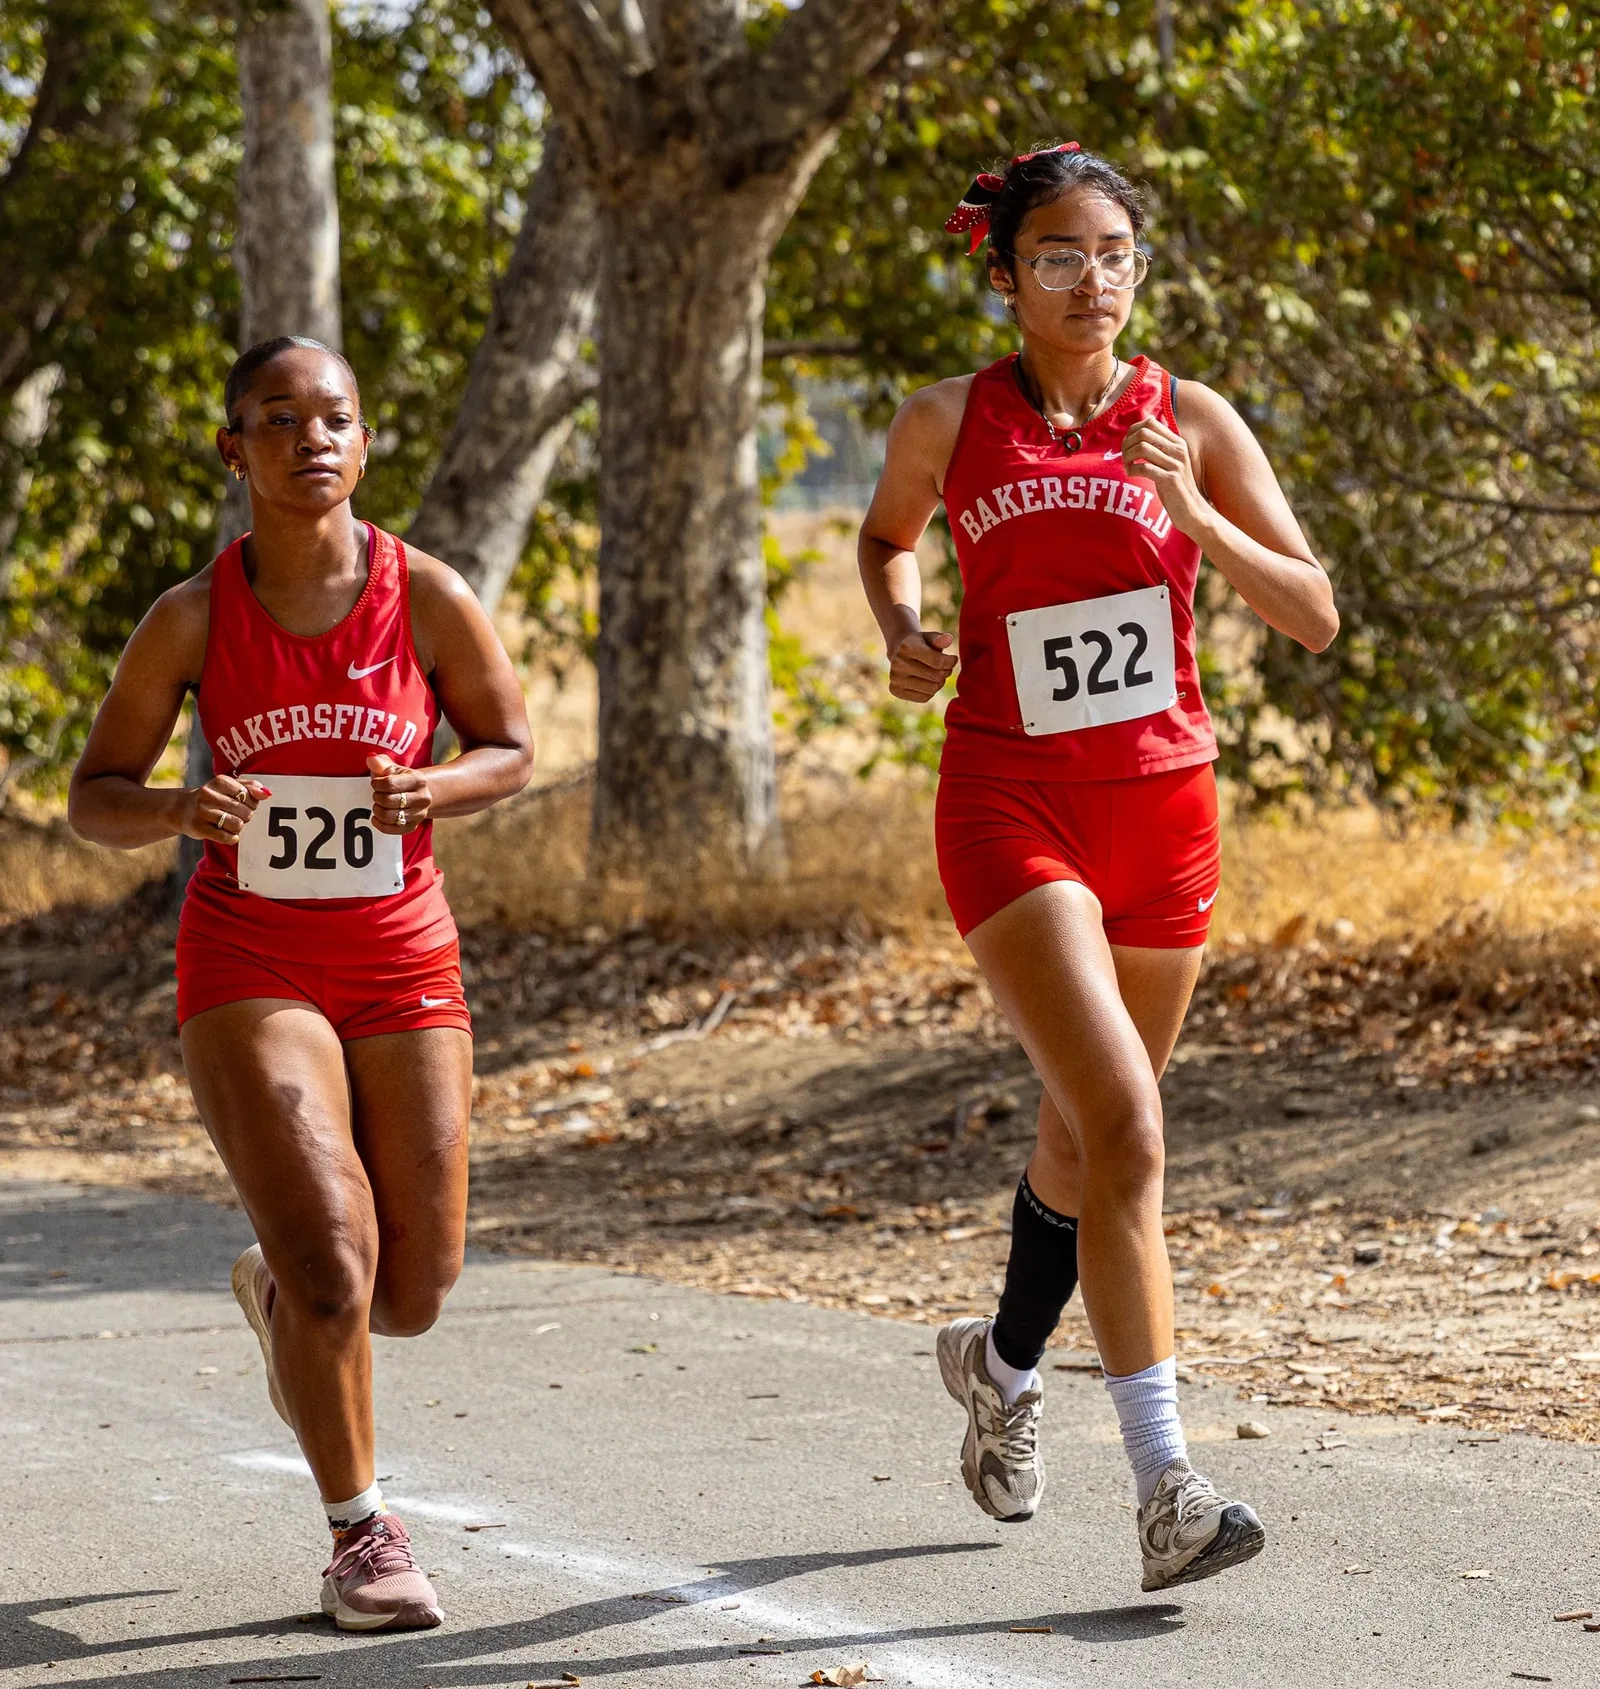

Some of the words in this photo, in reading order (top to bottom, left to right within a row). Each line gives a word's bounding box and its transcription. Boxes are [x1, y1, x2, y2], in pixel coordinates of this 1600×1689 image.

[959, 476, 1173, 544] BAKERSFIELD
[1043, 621, 1153, 702] 522
[216, 703, 418, 768] BAKERSFIELD
[268, 806, 374, 870] 526
[1020, 1178, 1075, 1231] ENSA
